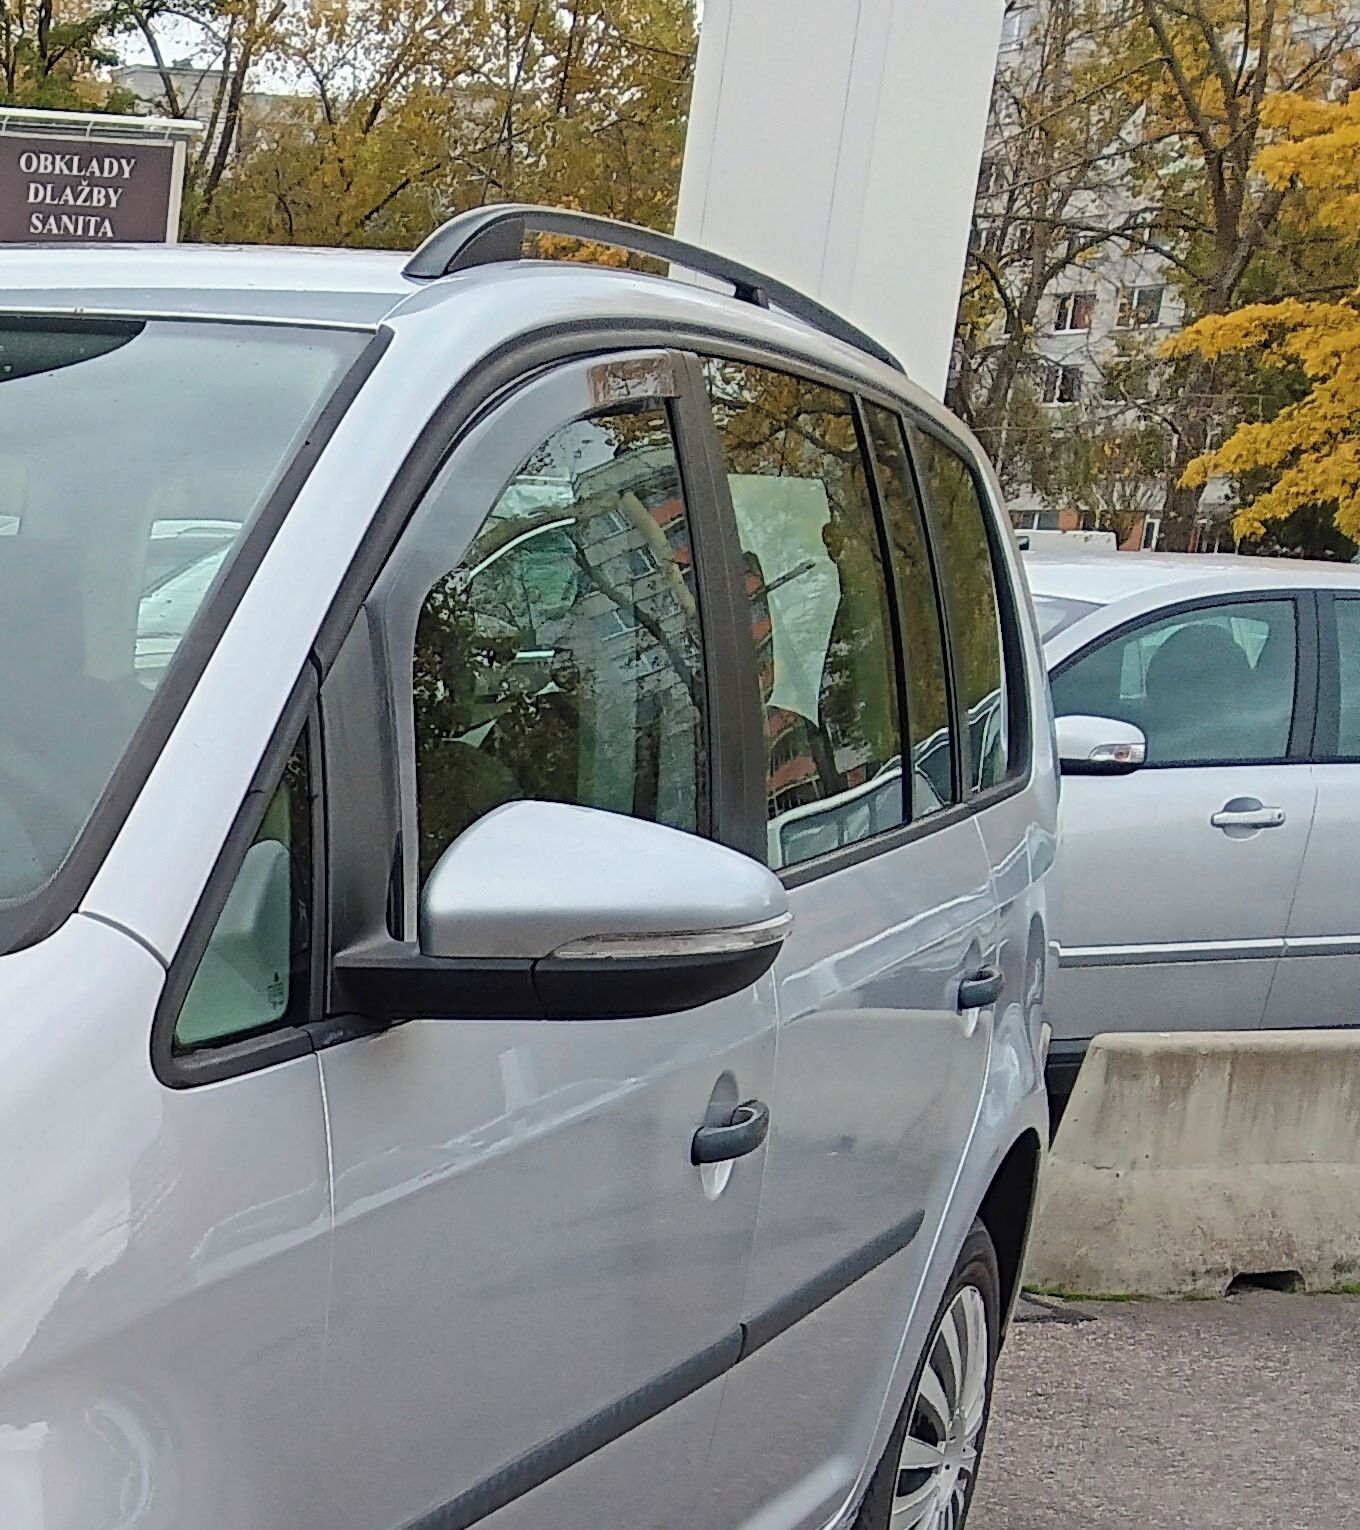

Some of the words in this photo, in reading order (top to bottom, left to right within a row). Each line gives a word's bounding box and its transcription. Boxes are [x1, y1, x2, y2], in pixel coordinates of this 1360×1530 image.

[18, 152, 137, 179] OBKLADY
[27, 179, 124, 209] DLAŽBY
[29, 212, 115, 238] SANITA
